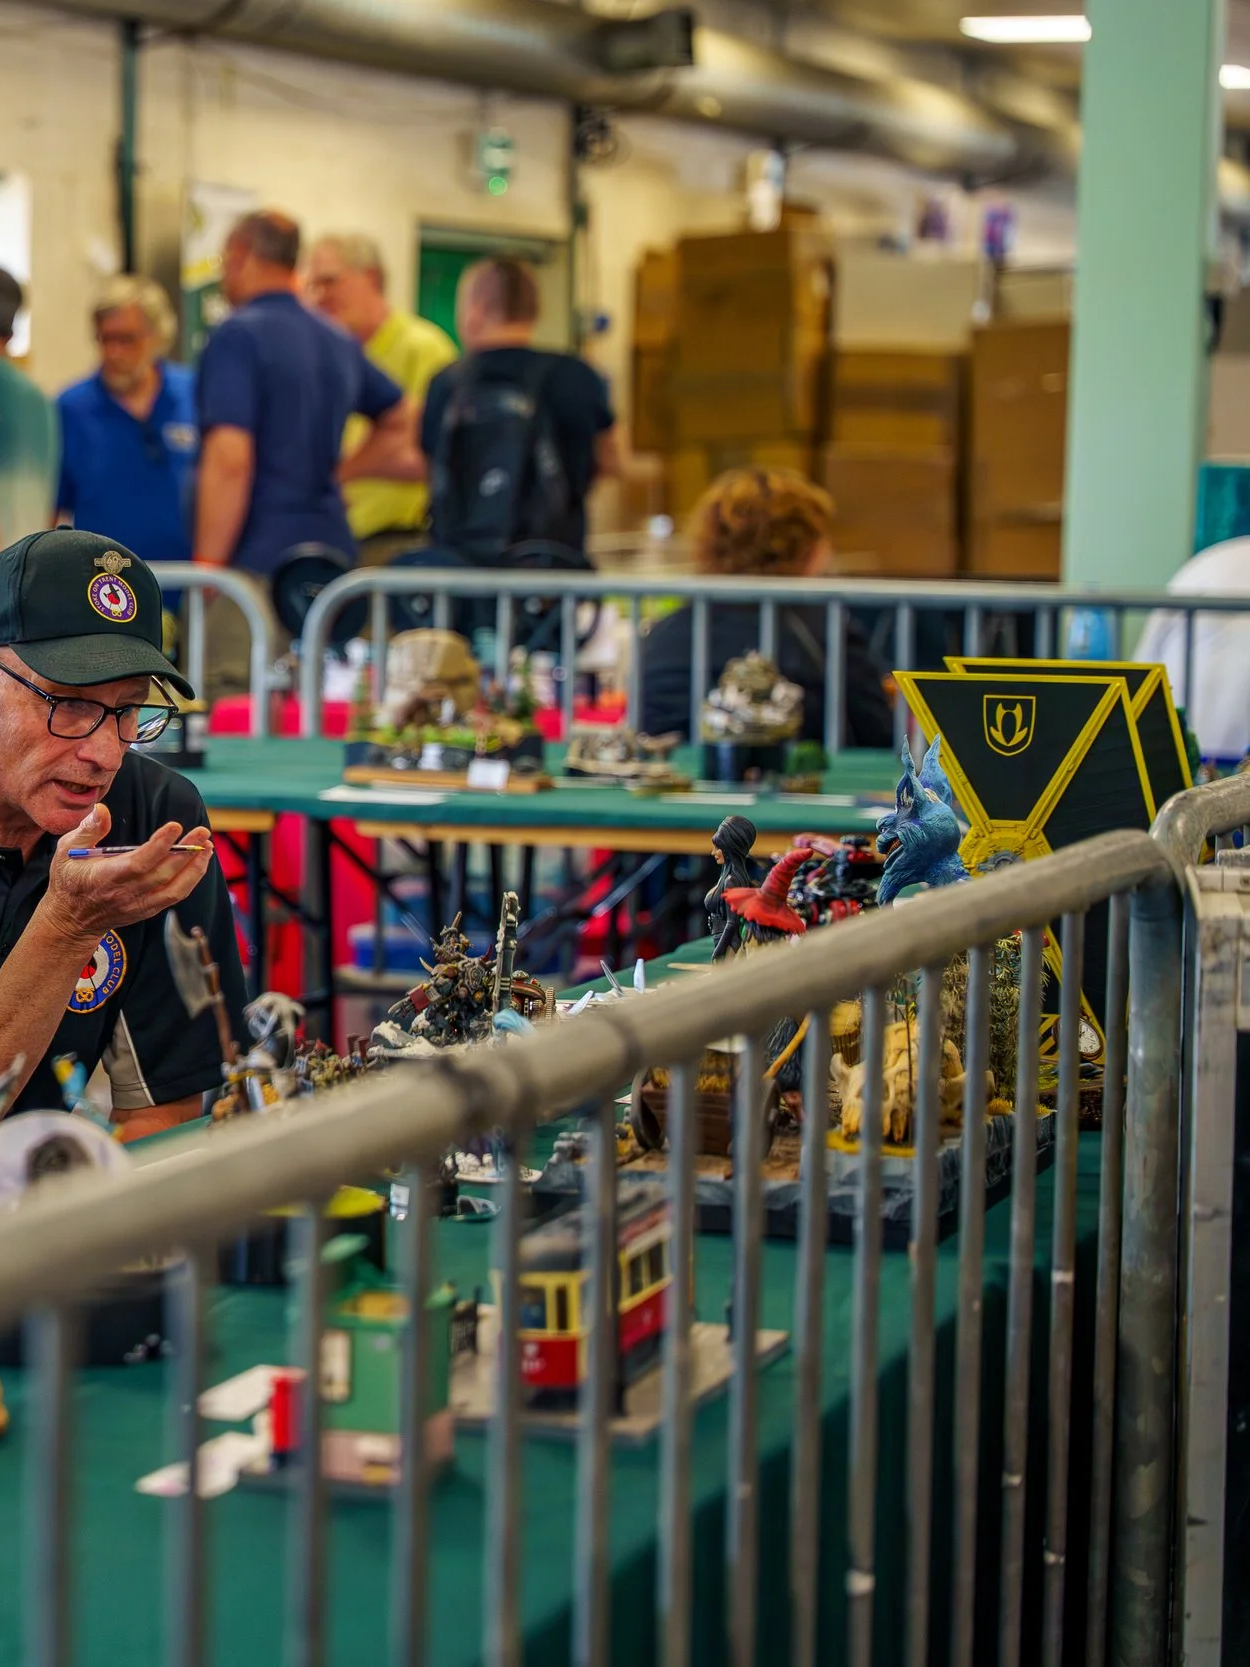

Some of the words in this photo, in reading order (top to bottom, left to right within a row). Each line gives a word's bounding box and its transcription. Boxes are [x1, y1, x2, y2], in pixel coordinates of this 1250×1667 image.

[92, 583, 100, 592] ON
[99, 576, 117, 584] TRENT
[118, 581, 132, 600] MODEL
[92, 593, 106, 612] STOKE
[106, 935, 121, 964] ODEL
[103, 967, 120, 994] CLUB
